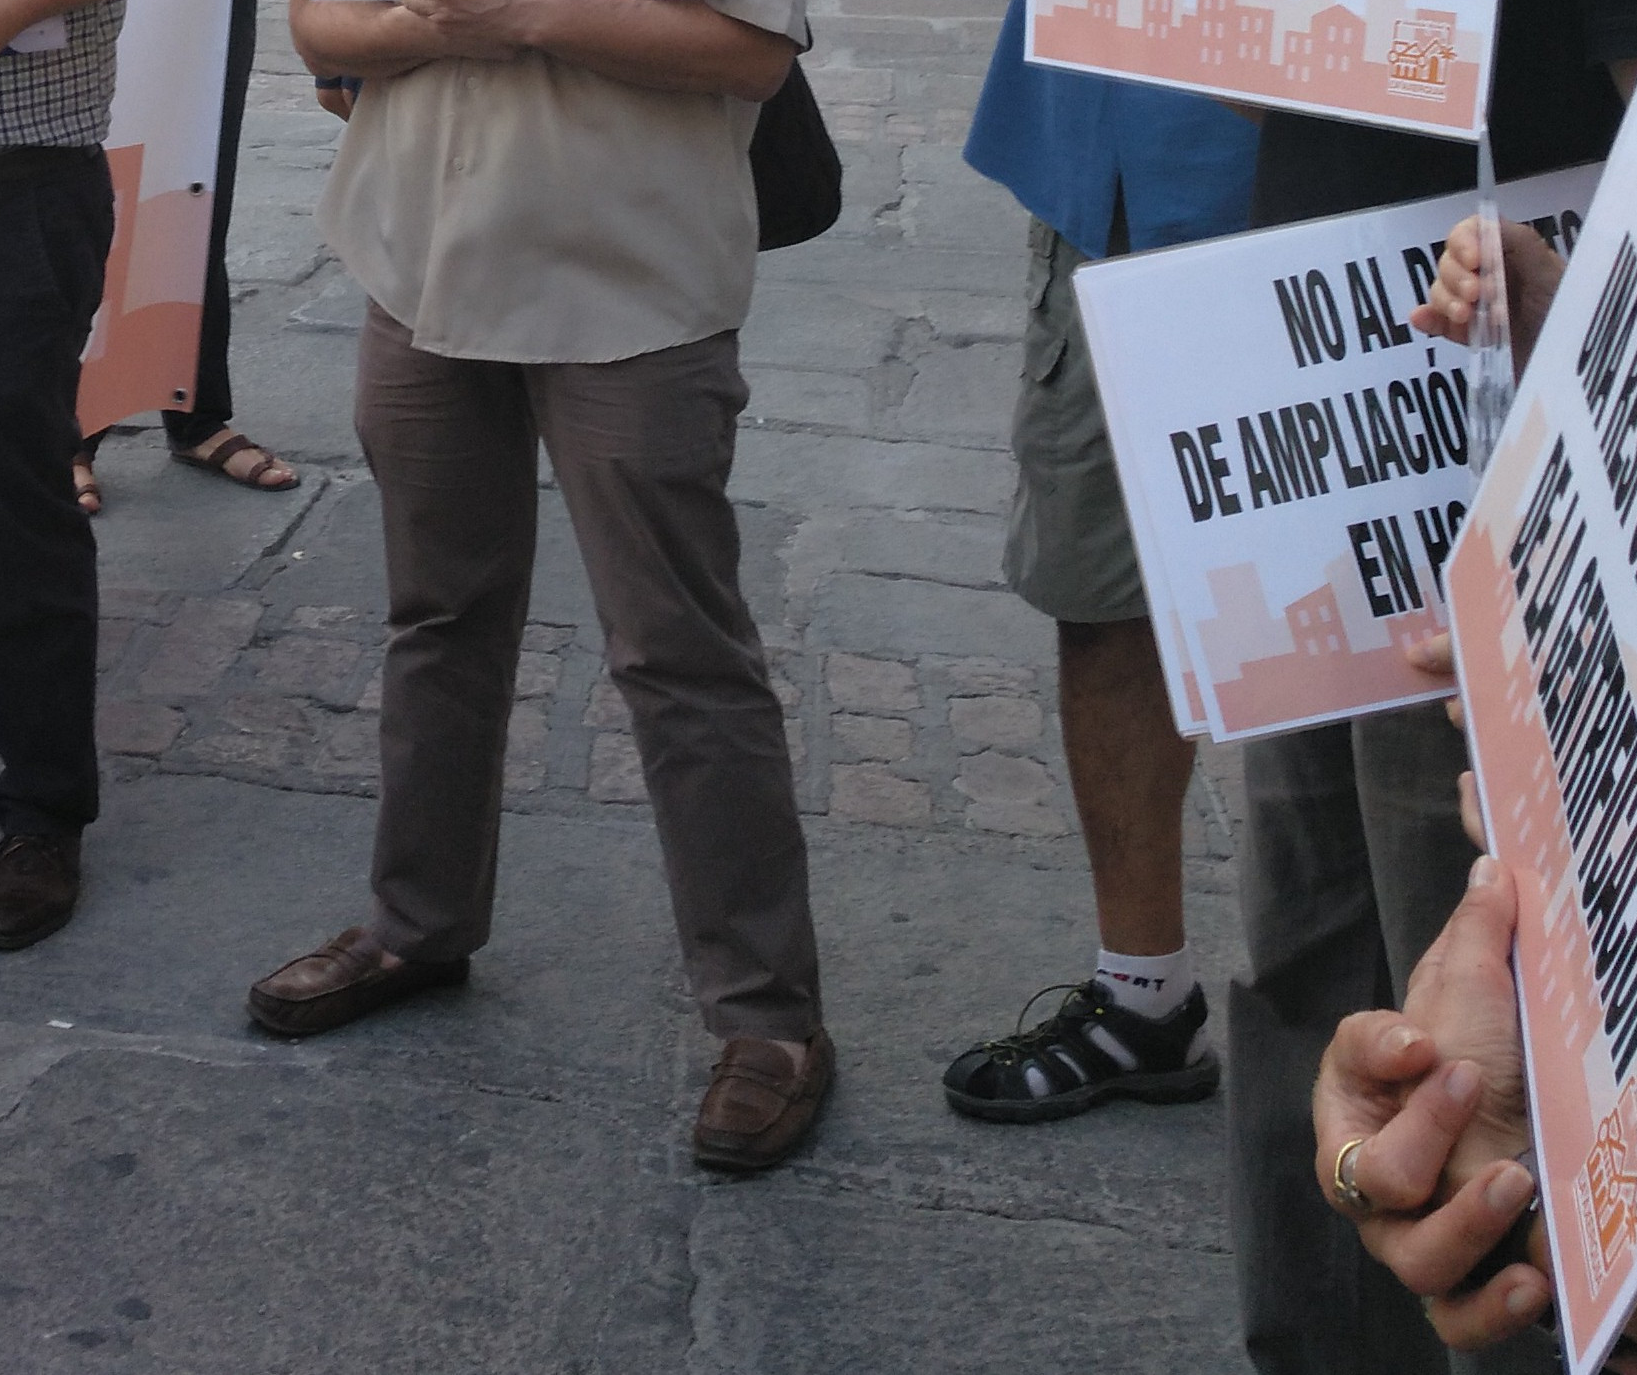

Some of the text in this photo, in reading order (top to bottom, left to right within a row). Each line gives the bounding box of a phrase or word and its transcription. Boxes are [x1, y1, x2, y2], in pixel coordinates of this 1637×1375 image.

[1273, 268, 1348, 370] NO
[1344, 256, 1413, 355] AL
[1169, 423, 1243, 523] DE
[1509, 432, 1574, 601] DE
[1347, 515, 1424, 619] EN
[1523, 491, 1587, 663] LA
